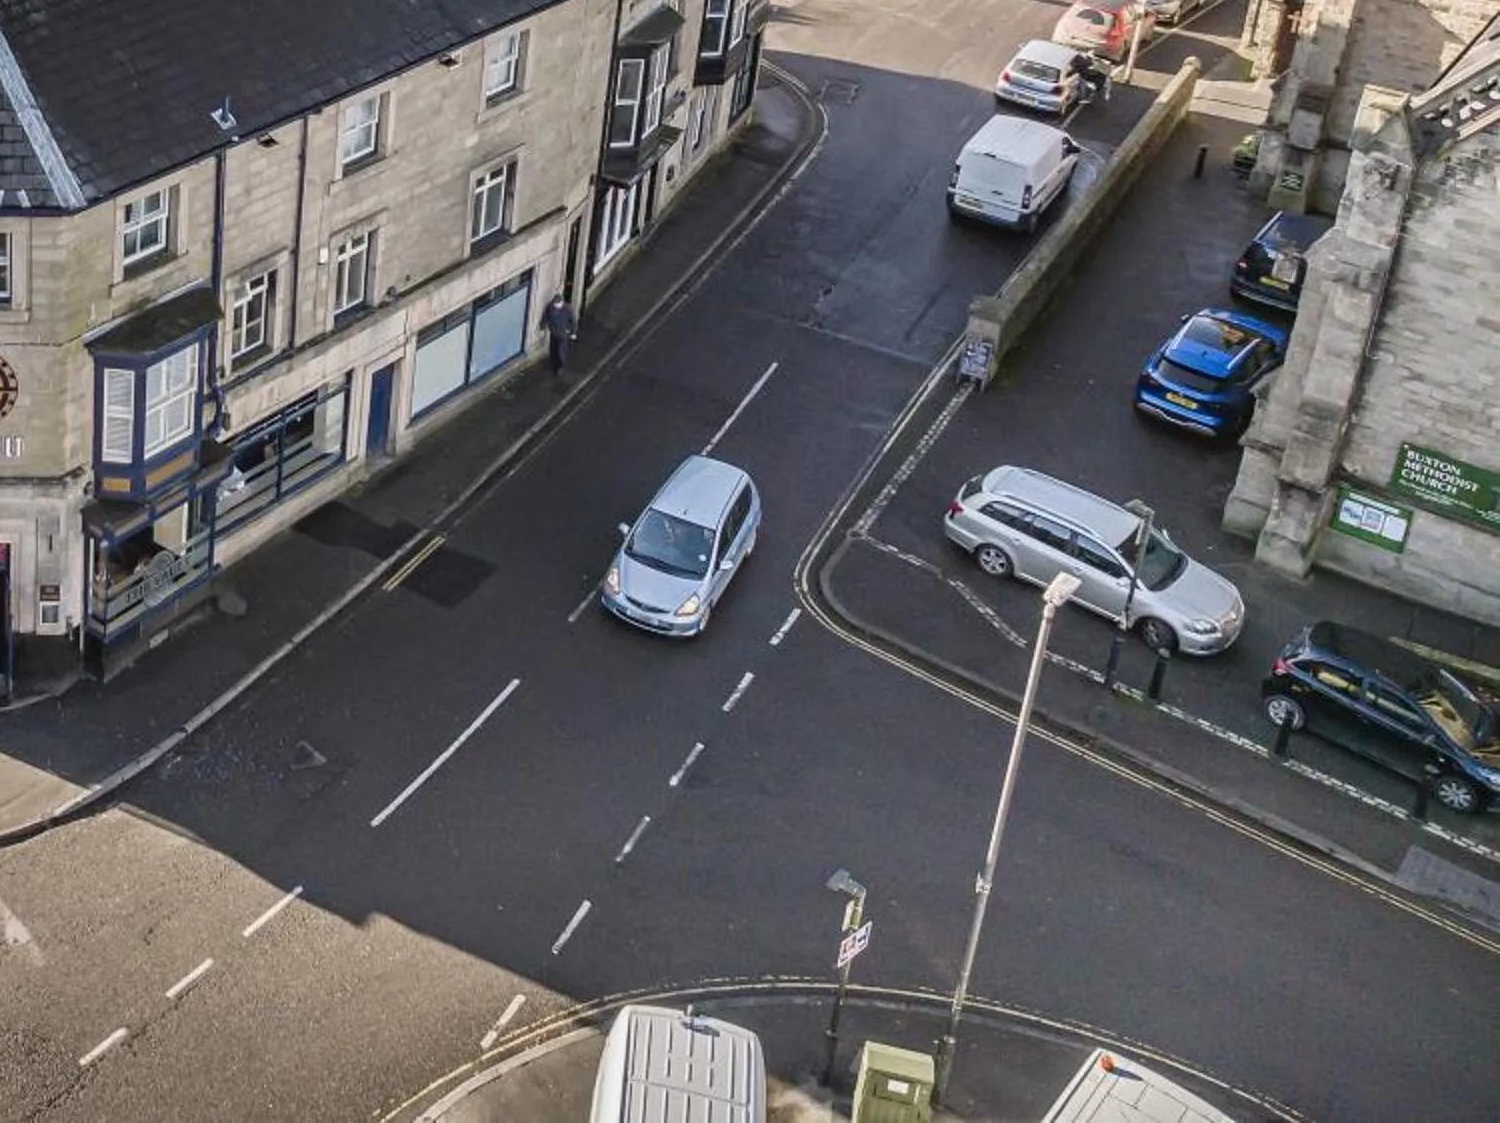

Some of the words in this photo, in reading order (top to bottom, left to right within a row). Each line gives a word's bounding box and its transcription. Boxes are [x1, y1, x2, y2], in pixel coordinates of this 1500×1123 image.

[1403, 460, 1480, 492] METHODIST
[1406, 450, 1461, 476] BUXTON
[1401, 468, 1457, 495] CHURCH
